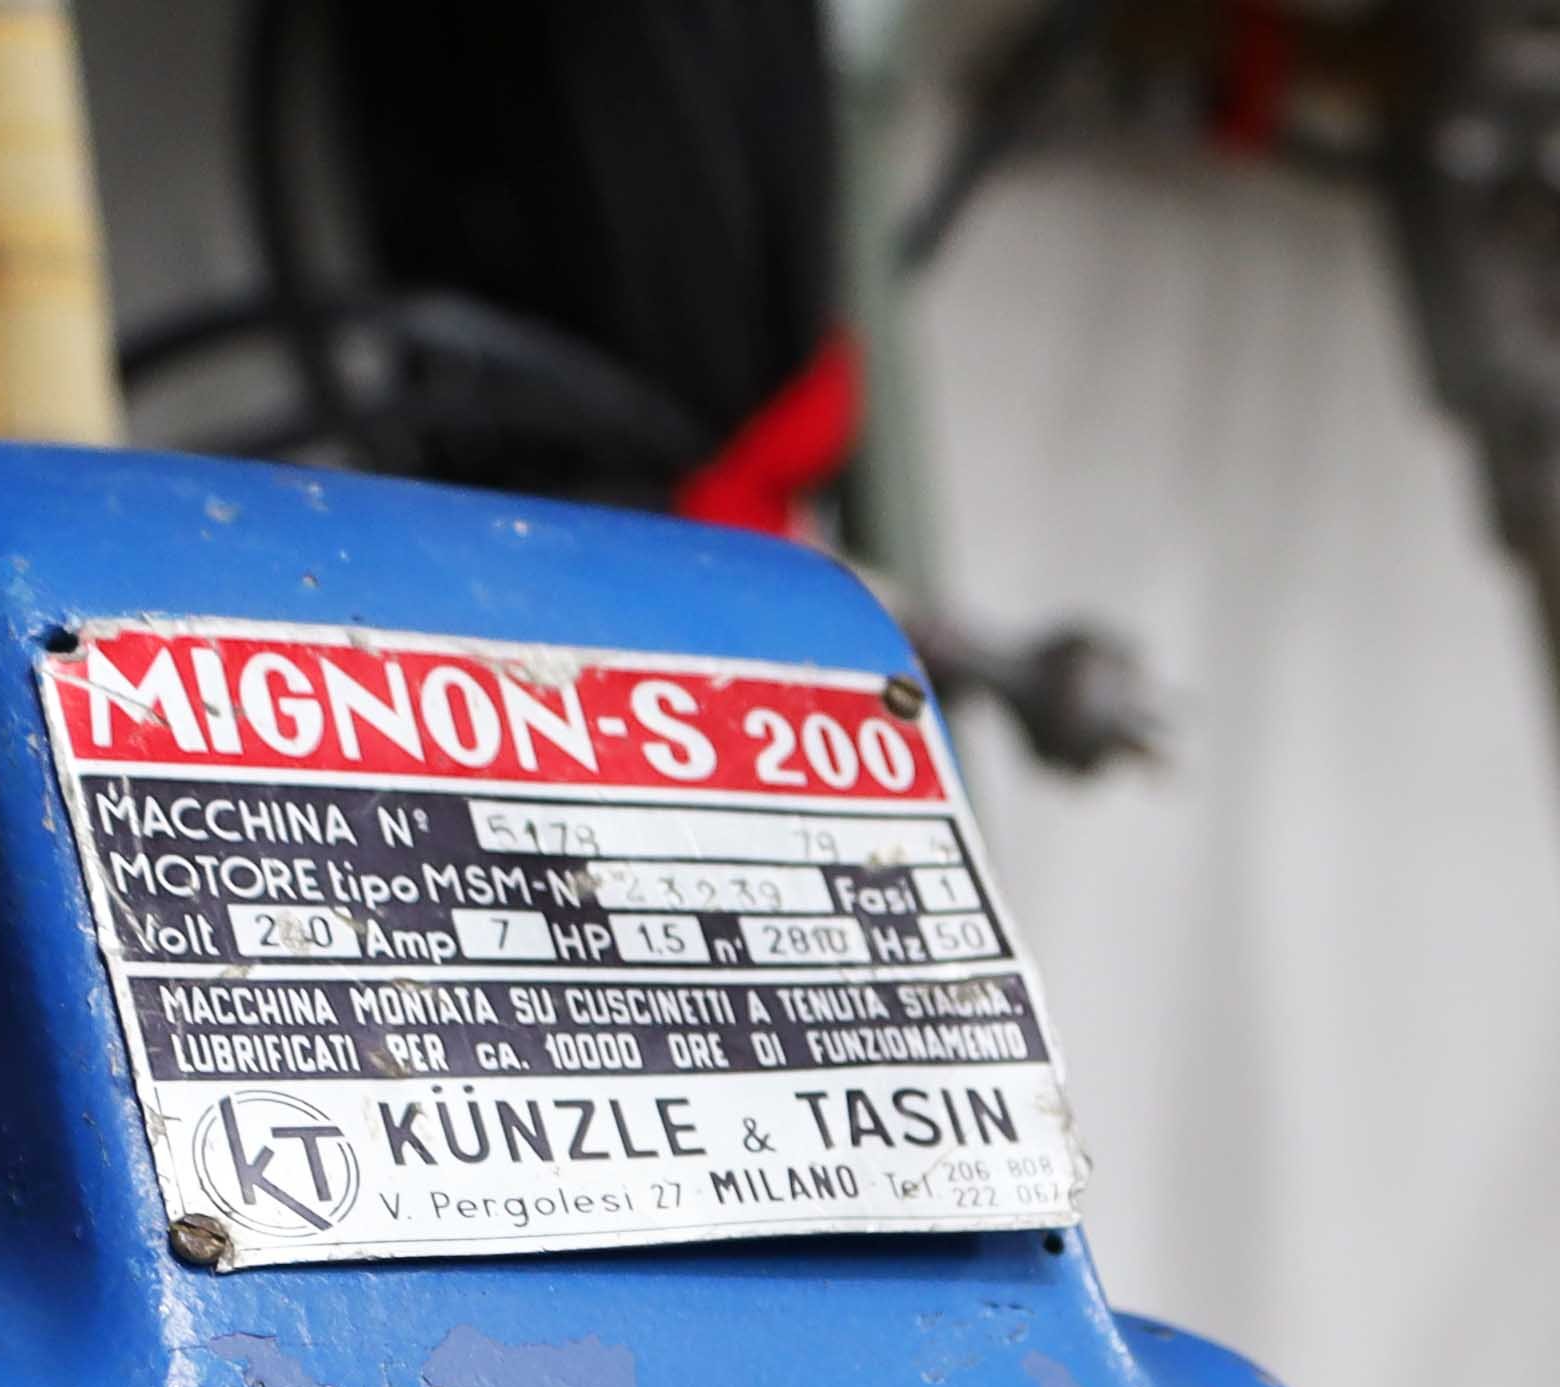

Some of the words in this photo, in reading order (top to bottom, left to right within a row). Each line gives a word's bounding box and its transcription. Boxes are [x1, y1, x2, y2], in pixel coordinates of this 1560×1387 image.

[86, 638, 717, 781] MIGNON-S
[742, 709, 916, 793] 200
[96, 792, 358, 846] MACCHINA
[109, 851, 324, 900] MOTORE
[331, 860, 419, 909] tipo
[834, 876, 917, 915] Fasi
[125, 912, 220, 956] Volt
[365, 918, 456, 965] Amp
[490, 918, 511, 950] 7
[551, 922, 611, 962] HP
[871, 925, 927, 963] Hz
[936, 922, 985, 951] 50
[159, 985, 339, 1026] MACCHINA
[348, 985, 499, 1026] MONTATA
[510, 987, 556, 1026] SU
[568, 987, 737, 1026] CUSCINETTI
[748, 988, 774, 1024] A
[782, 986, 889, 1023] TENUTA
[171, 1033, 362, 1074] LUBRIFICATI
[386, 1032, 449, 1072] PER
[545, 1031, 643, 1070] 10000
[668, 1031, 730, 1070] ORE
[751, 1031, 787, 1067] DI
[806, 1022, 1028, 1065] FUNZIONAMENTO
[378, 1085, 707, 1166] KÜNZLE
[743, 1117, 776, 1154] &
[795, 1087, 1019, 1151] TASIN
[379, 1193, 413, 1221] V.
[429, 1185, 633, 1228] Pergolesi
[651, 1182, 683, 1211] 27
[709, 1164, 859, 1205] MILANO
[941, 1159, 991, 1183] 206
[951, 1184, 999, 1208] 222
